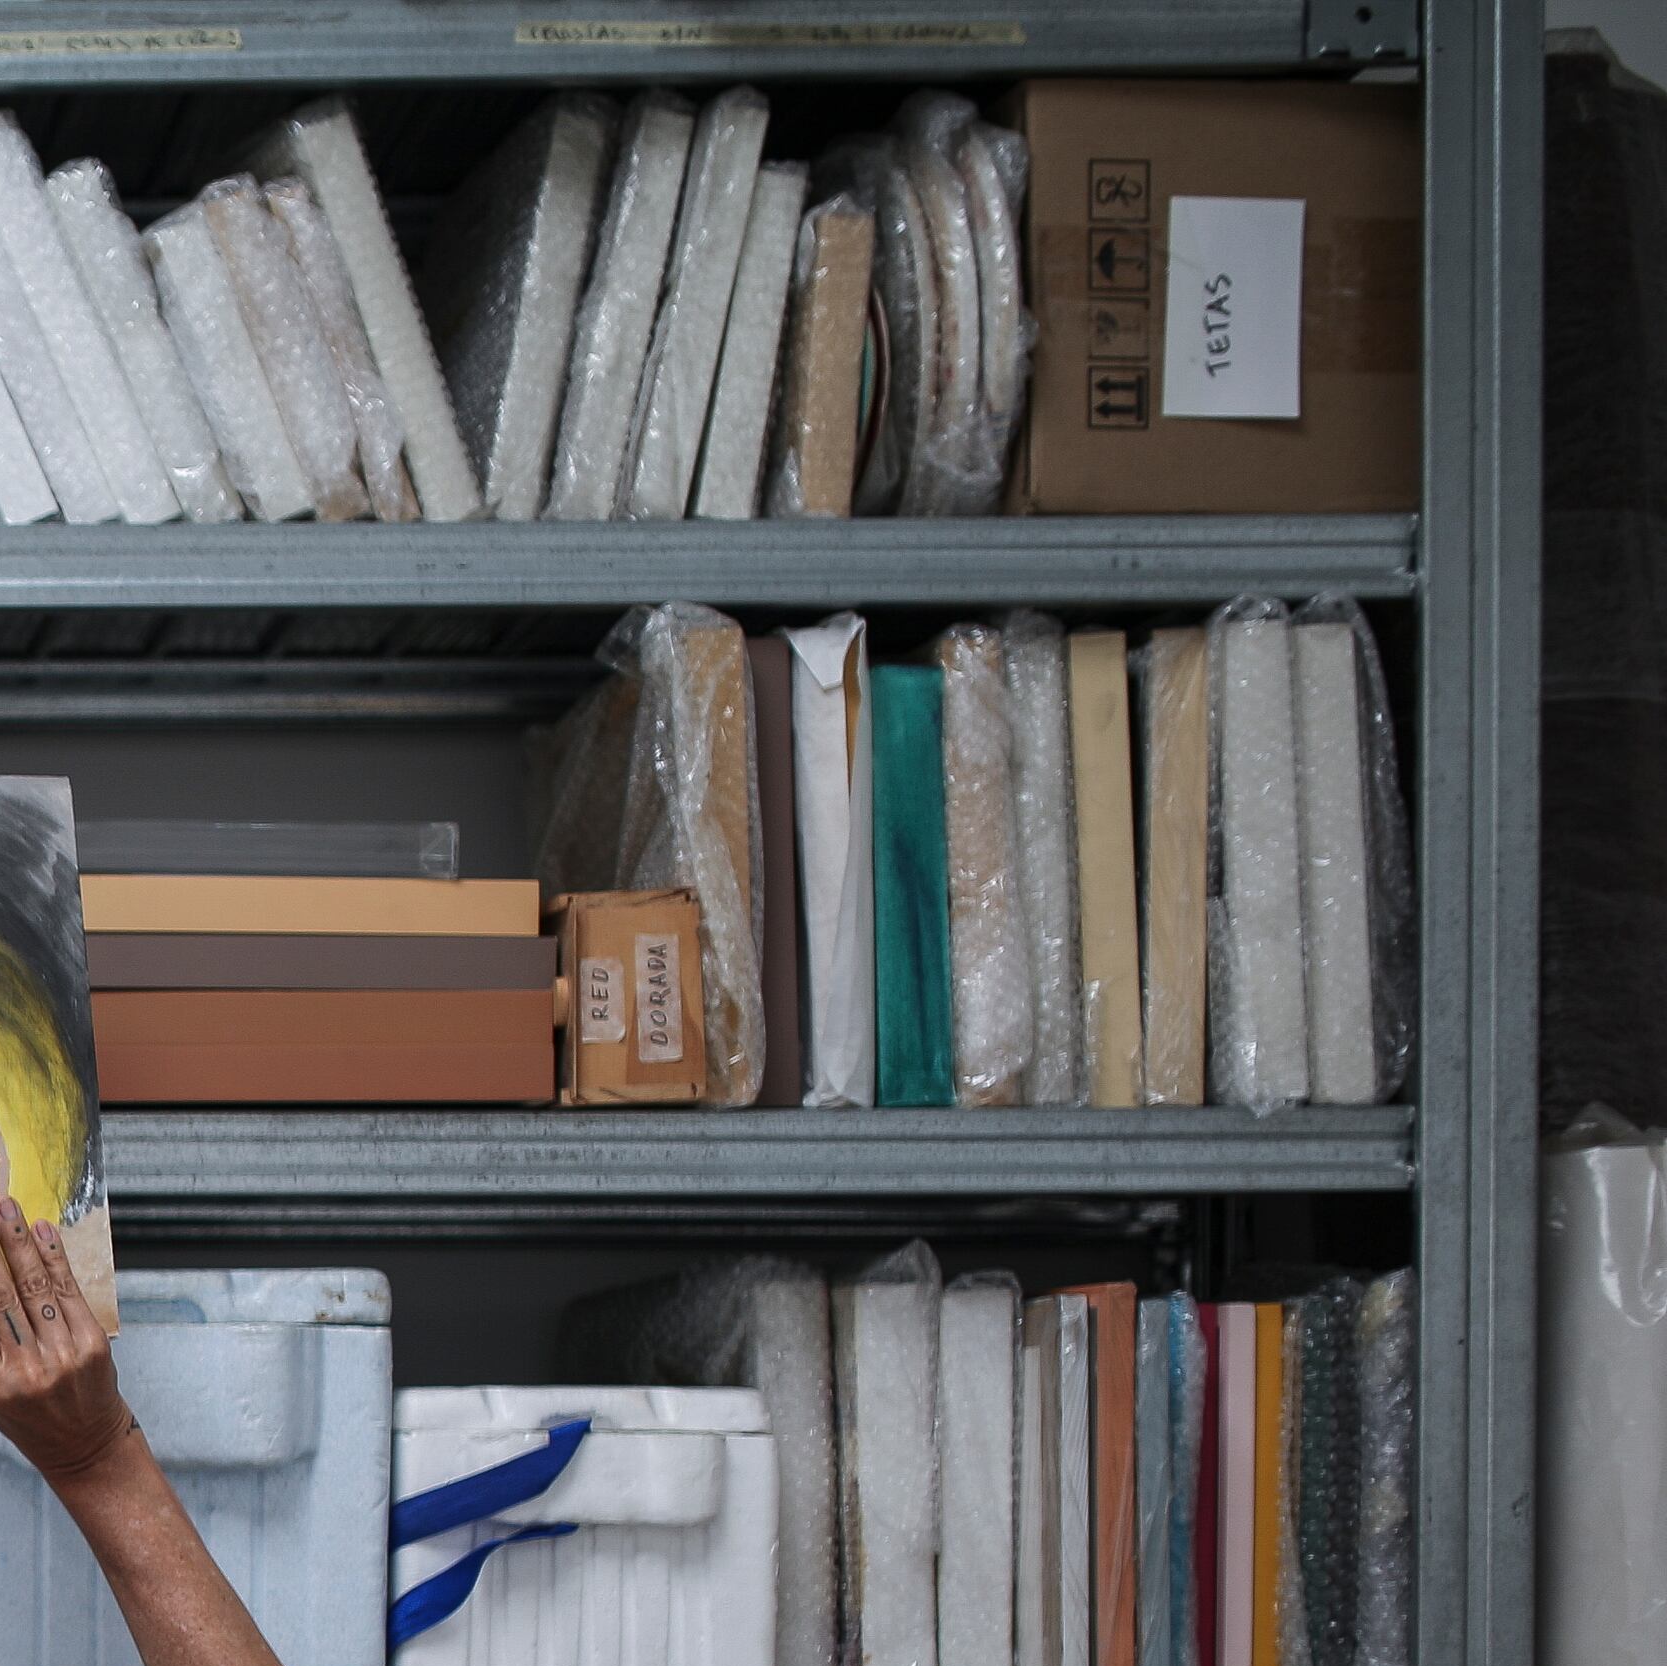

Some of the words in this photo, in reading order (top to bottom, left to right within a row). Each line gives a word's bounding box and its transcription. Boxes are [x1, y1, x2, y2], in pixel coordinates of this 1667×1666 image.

[1204, 272, 1234, 378] TETAS
[591, 967, 610, 1022] RED
[647, 942, 672, 1047] DORADA
